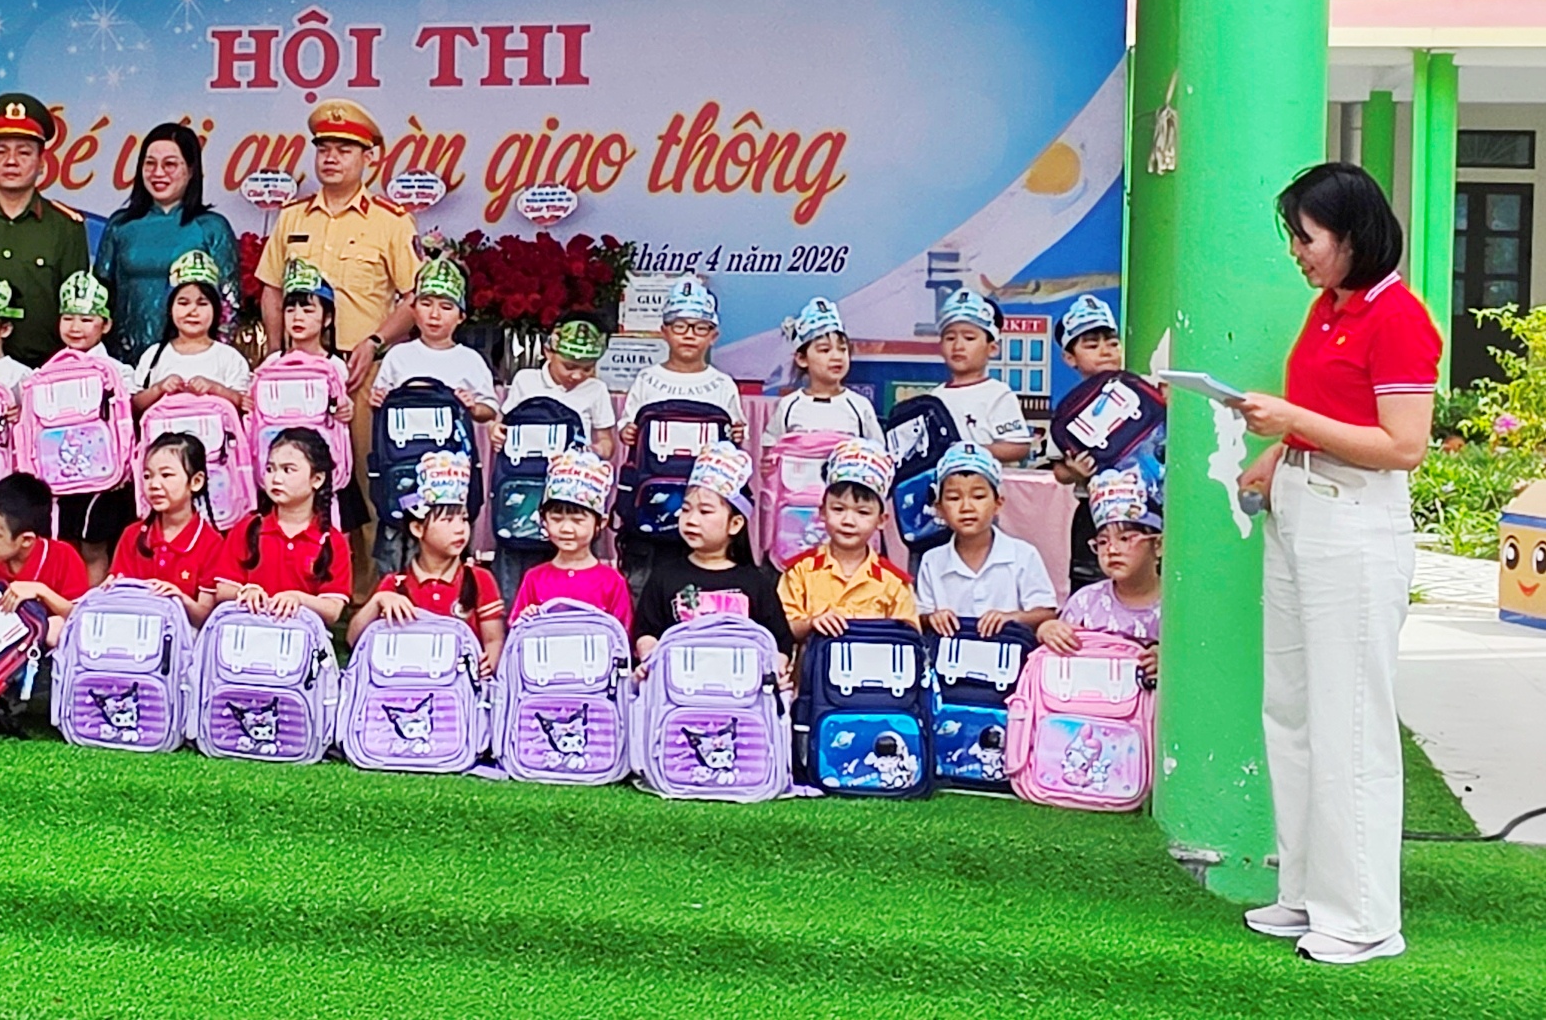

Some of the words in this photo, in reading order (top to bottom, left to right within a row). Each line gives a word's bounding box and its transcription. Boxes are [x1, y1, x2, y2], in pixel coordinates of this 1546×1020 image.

[209, 8, 383, 104] HỘI
[414, 22, 592, 88] THI
[223, 133, 306, 192] an
[483, 116, 636, 224] giao
[647, 100, 847, 225] thông
[628, 242, 702, 275] tháng
[705, 244, 723, 272] 4
[725, 245, 782, 273] năm
[786, 244, 849, 273] 2026
